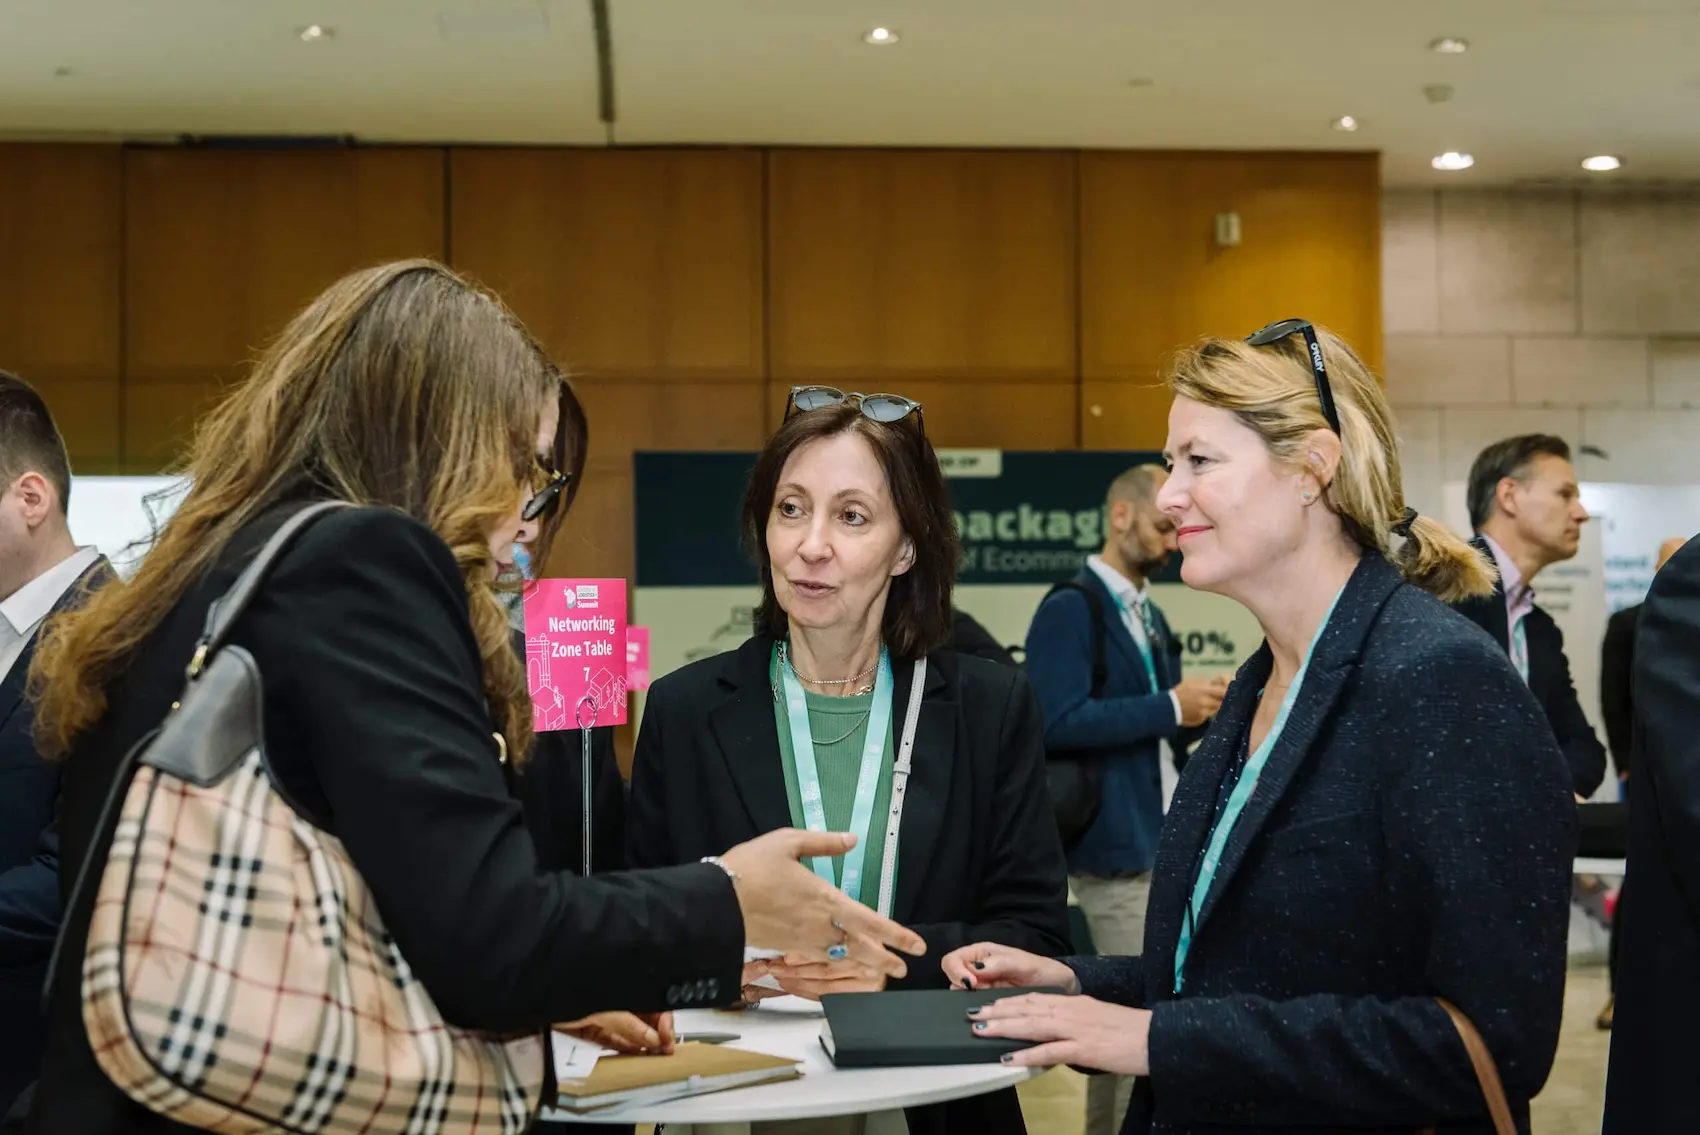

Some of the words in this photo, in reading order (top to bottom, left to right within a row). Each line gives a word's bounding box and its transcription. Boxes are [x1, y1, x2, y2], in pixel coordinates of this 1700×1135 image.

[1310, 342, 1325, 372] OAKLEY
[577, 600, 599, 609] Summit
[549, 615, 615, 634] Networking
[551, 642, 581, 657] Zone
[583, 640, 612, 656] Table
[1174, 630, 1235, 656] 0%
[583, 667, 591, 681] 7
